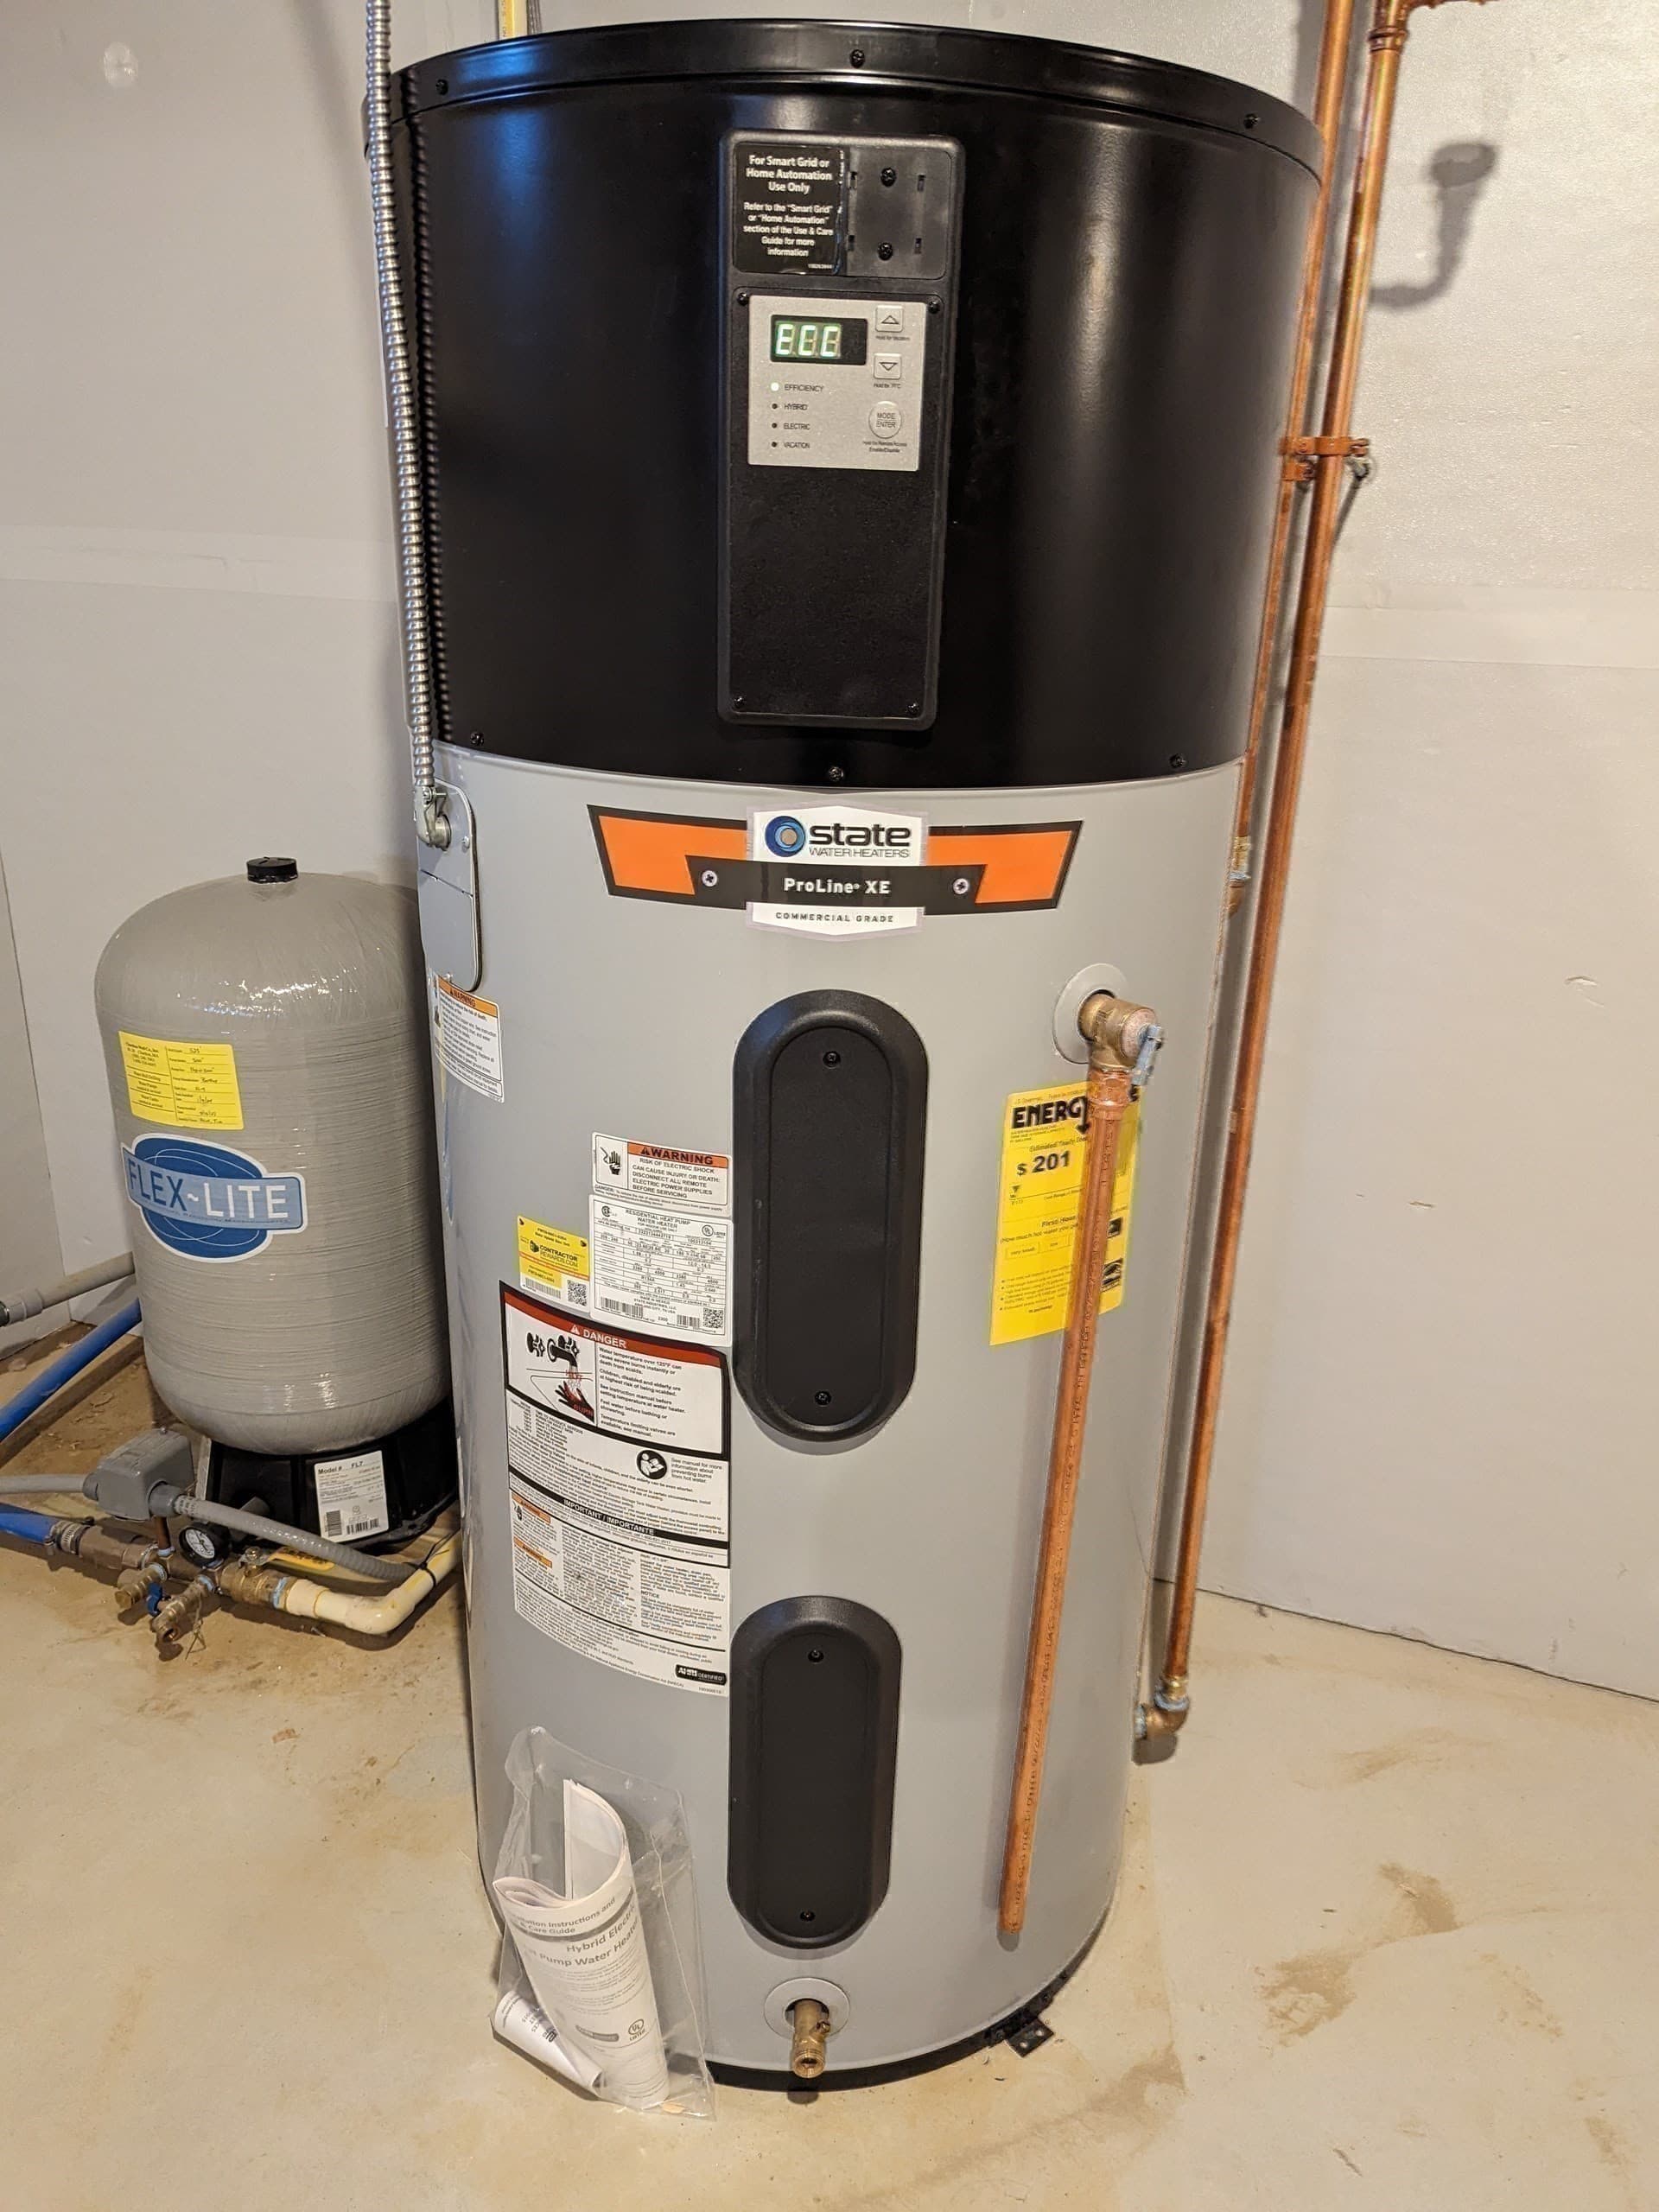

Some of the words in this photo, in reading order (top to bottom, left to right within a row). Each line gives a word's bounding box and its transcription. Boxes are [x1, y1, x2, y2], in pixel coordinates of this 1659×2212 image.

[749, 156, 765, 165] For
[766, 156, 796, 167] Smart
[798, 157, 818, 168] Grid
[746, 168, 774, 178] Home
[777, 169, 832, 180] Automation
[768, 181, 786, 191] Use
[787, 182, 810, 194] Only
[793, 226, 807, 235] Use
[817, 227, 834, 236] Care
[785, 237, 795, 245] for
[767, 248, 809, 257] information
[784, 384, 824, 392] EFFICIENCY
[809, 823, 911, 847] state
[809, 847, 852, 857] WATER
[853, 848, 909, 858] HEATERS
[864, 880, 892, 894] XE
[776, 912, 850, 923] COMMERCIAL
[1029, 1141, 1057, 1152] Estimated
[652, 1148, 714, 1165] WARNING
[664, 1162, 692, 1171] ELECTRIC
[1017, 1163, 1027, 1177] $
[1032, 1150, 1071, 1173] 201
[632, 1171, 669, 1182] DISCONNECT
[632, 1178, 659, 1187] ELECTRIC
[660, 1182, 683, 1191] POWER
[683, 1186, 712, 1195] SUPPLIES
[632, 1185, 655, 1193] BEFORE
[657, 1188, 688, 1198] SERVICING
[626, 1210, 658, 1221] RESIDENTIAL
[657, 1220, 678, 1229] HEATER
[1042, 1218, 1059, 1228] First
[540, 1244, 578, 1262] CONTRACTOR
[583, 1329, 626, 1348] DANGER
[613, 1351, 643, 1363] temperature
[600, 1369, 620, 1379] Children,
[646, 1365, 669, 1374] instantly
[605, 1376, 622, 1385] highest
[609, 1386, 635, 1396] instruction
[600, 1390, 616, 1399] setting
[616, 1395, 645, 1405] temperature
[641, 1410, 660, 1419] bathing
[601, 1414, 629, 1426] Temperature
[630, 1422, 648, 1431] limiting
[671, 1469, 696, 1478] preventing
[563, 1499, 602, 1519] IMPORTANT
[607, 1516, 655, 1535] IMPORTANTE
[641, 1590, 659, 1599] NOTICE
[548, 1911, 601, 1928] Instructions
[601, 1897, 615, 1912] and
[566, 1934, 606, 1953] Hybrid
[540, 1953, 572, 1967] Pump
[575, 1949, 611, 1966] Water
